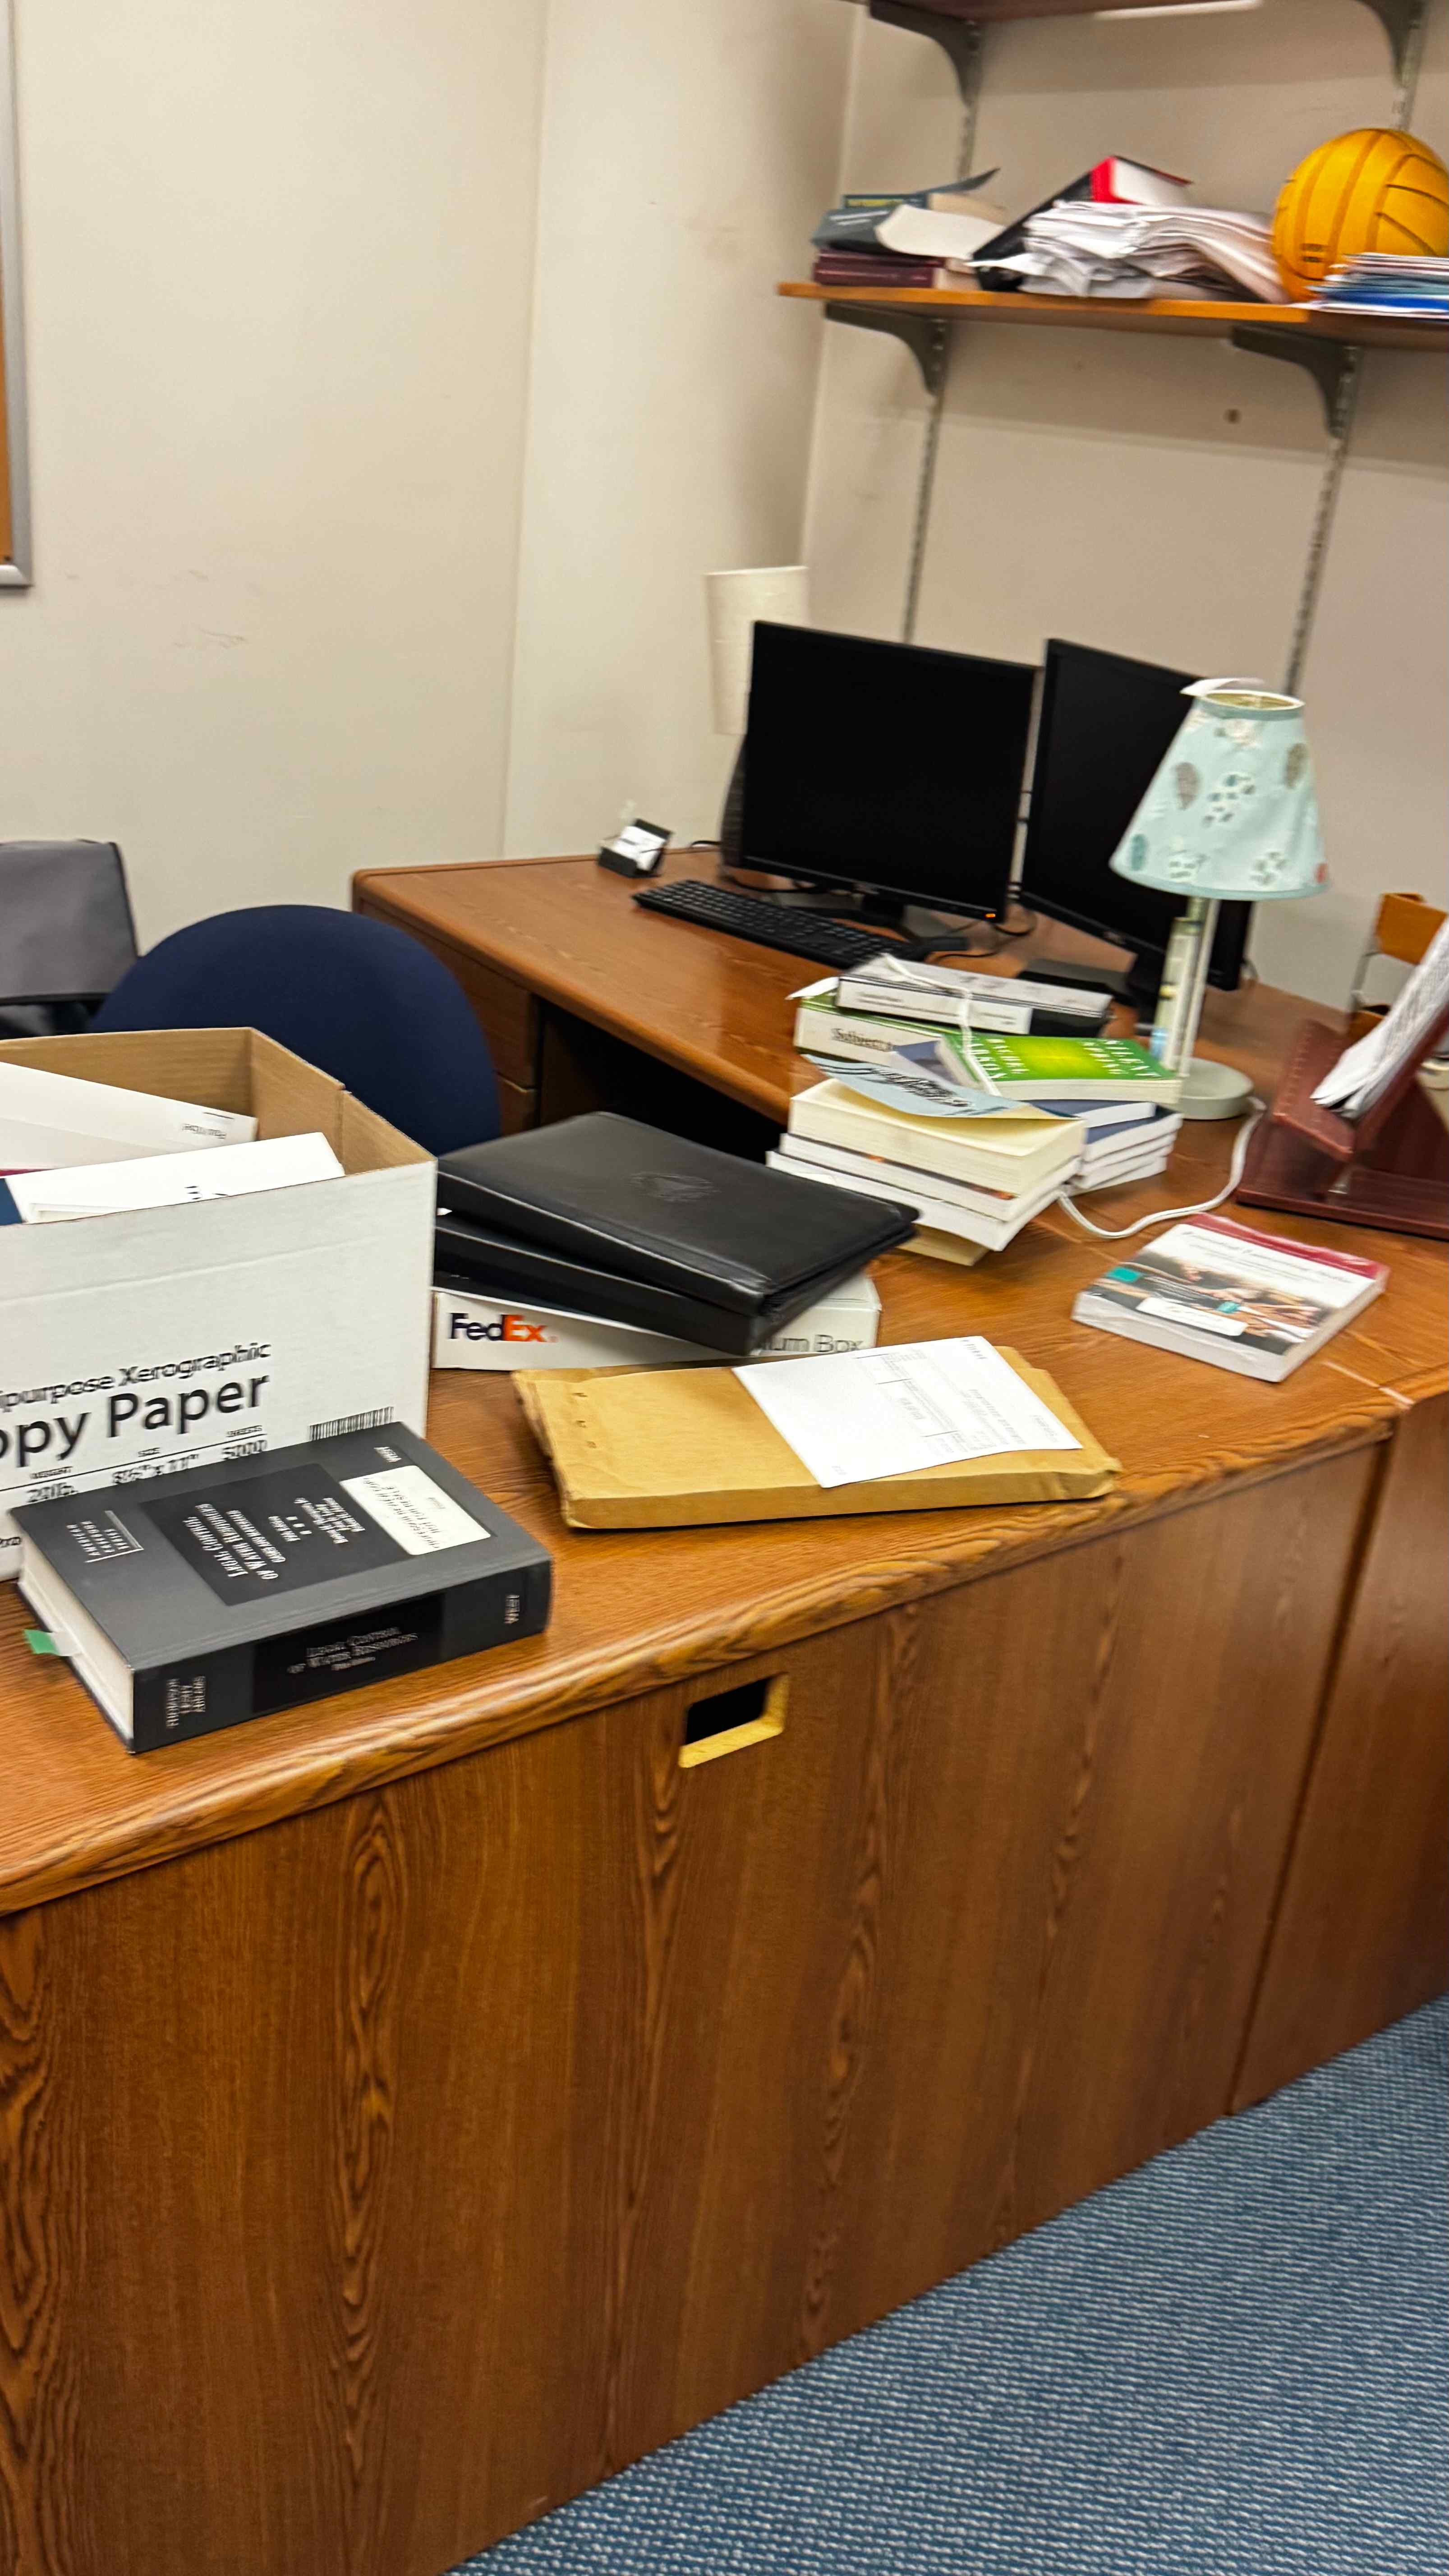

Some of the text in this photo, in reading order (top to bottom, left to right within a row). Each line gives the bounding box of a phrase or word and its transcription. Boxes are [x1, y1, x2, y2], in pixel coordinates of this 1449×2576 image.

[449, 1312, 547, 1343] FedEx
[814, 1334, 863, 1352] Box
[119, 1343, 271, 1386] Xerographic
[107, 1375, 270, 1438] Paper
[195, 1503, 243, 1542] RESOURCES
[182, 1516, 248, 1577] LEGAL CONTROL
[232, 1542, 267, 1569] WATER
